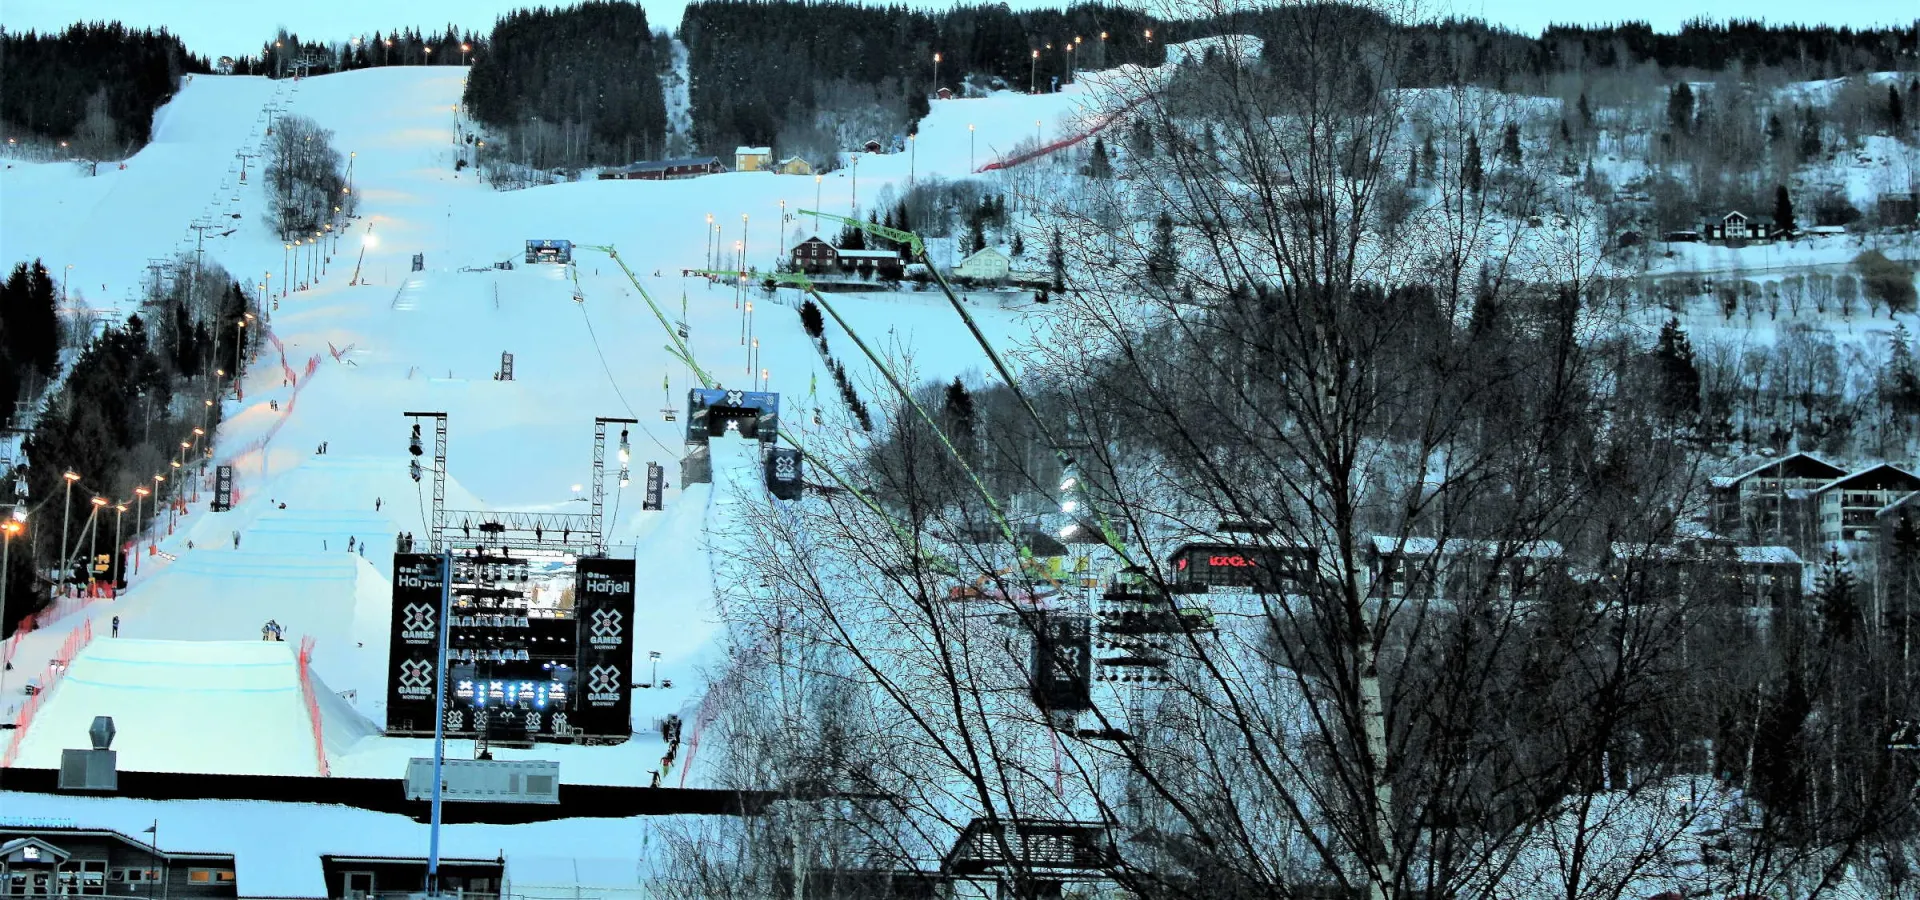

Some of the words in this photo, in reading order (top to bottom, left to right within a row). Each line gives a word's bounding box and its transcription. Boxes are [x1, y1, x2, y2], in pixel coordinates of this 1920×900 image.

[586, 580, 630, 595] Hafjell
[402, 630, 435, 639] GAMES
[590, 636, 622, 644] GAMES
[398, 686, 431, 695] GAMES
[588, 692, 620, 700] GAMES
